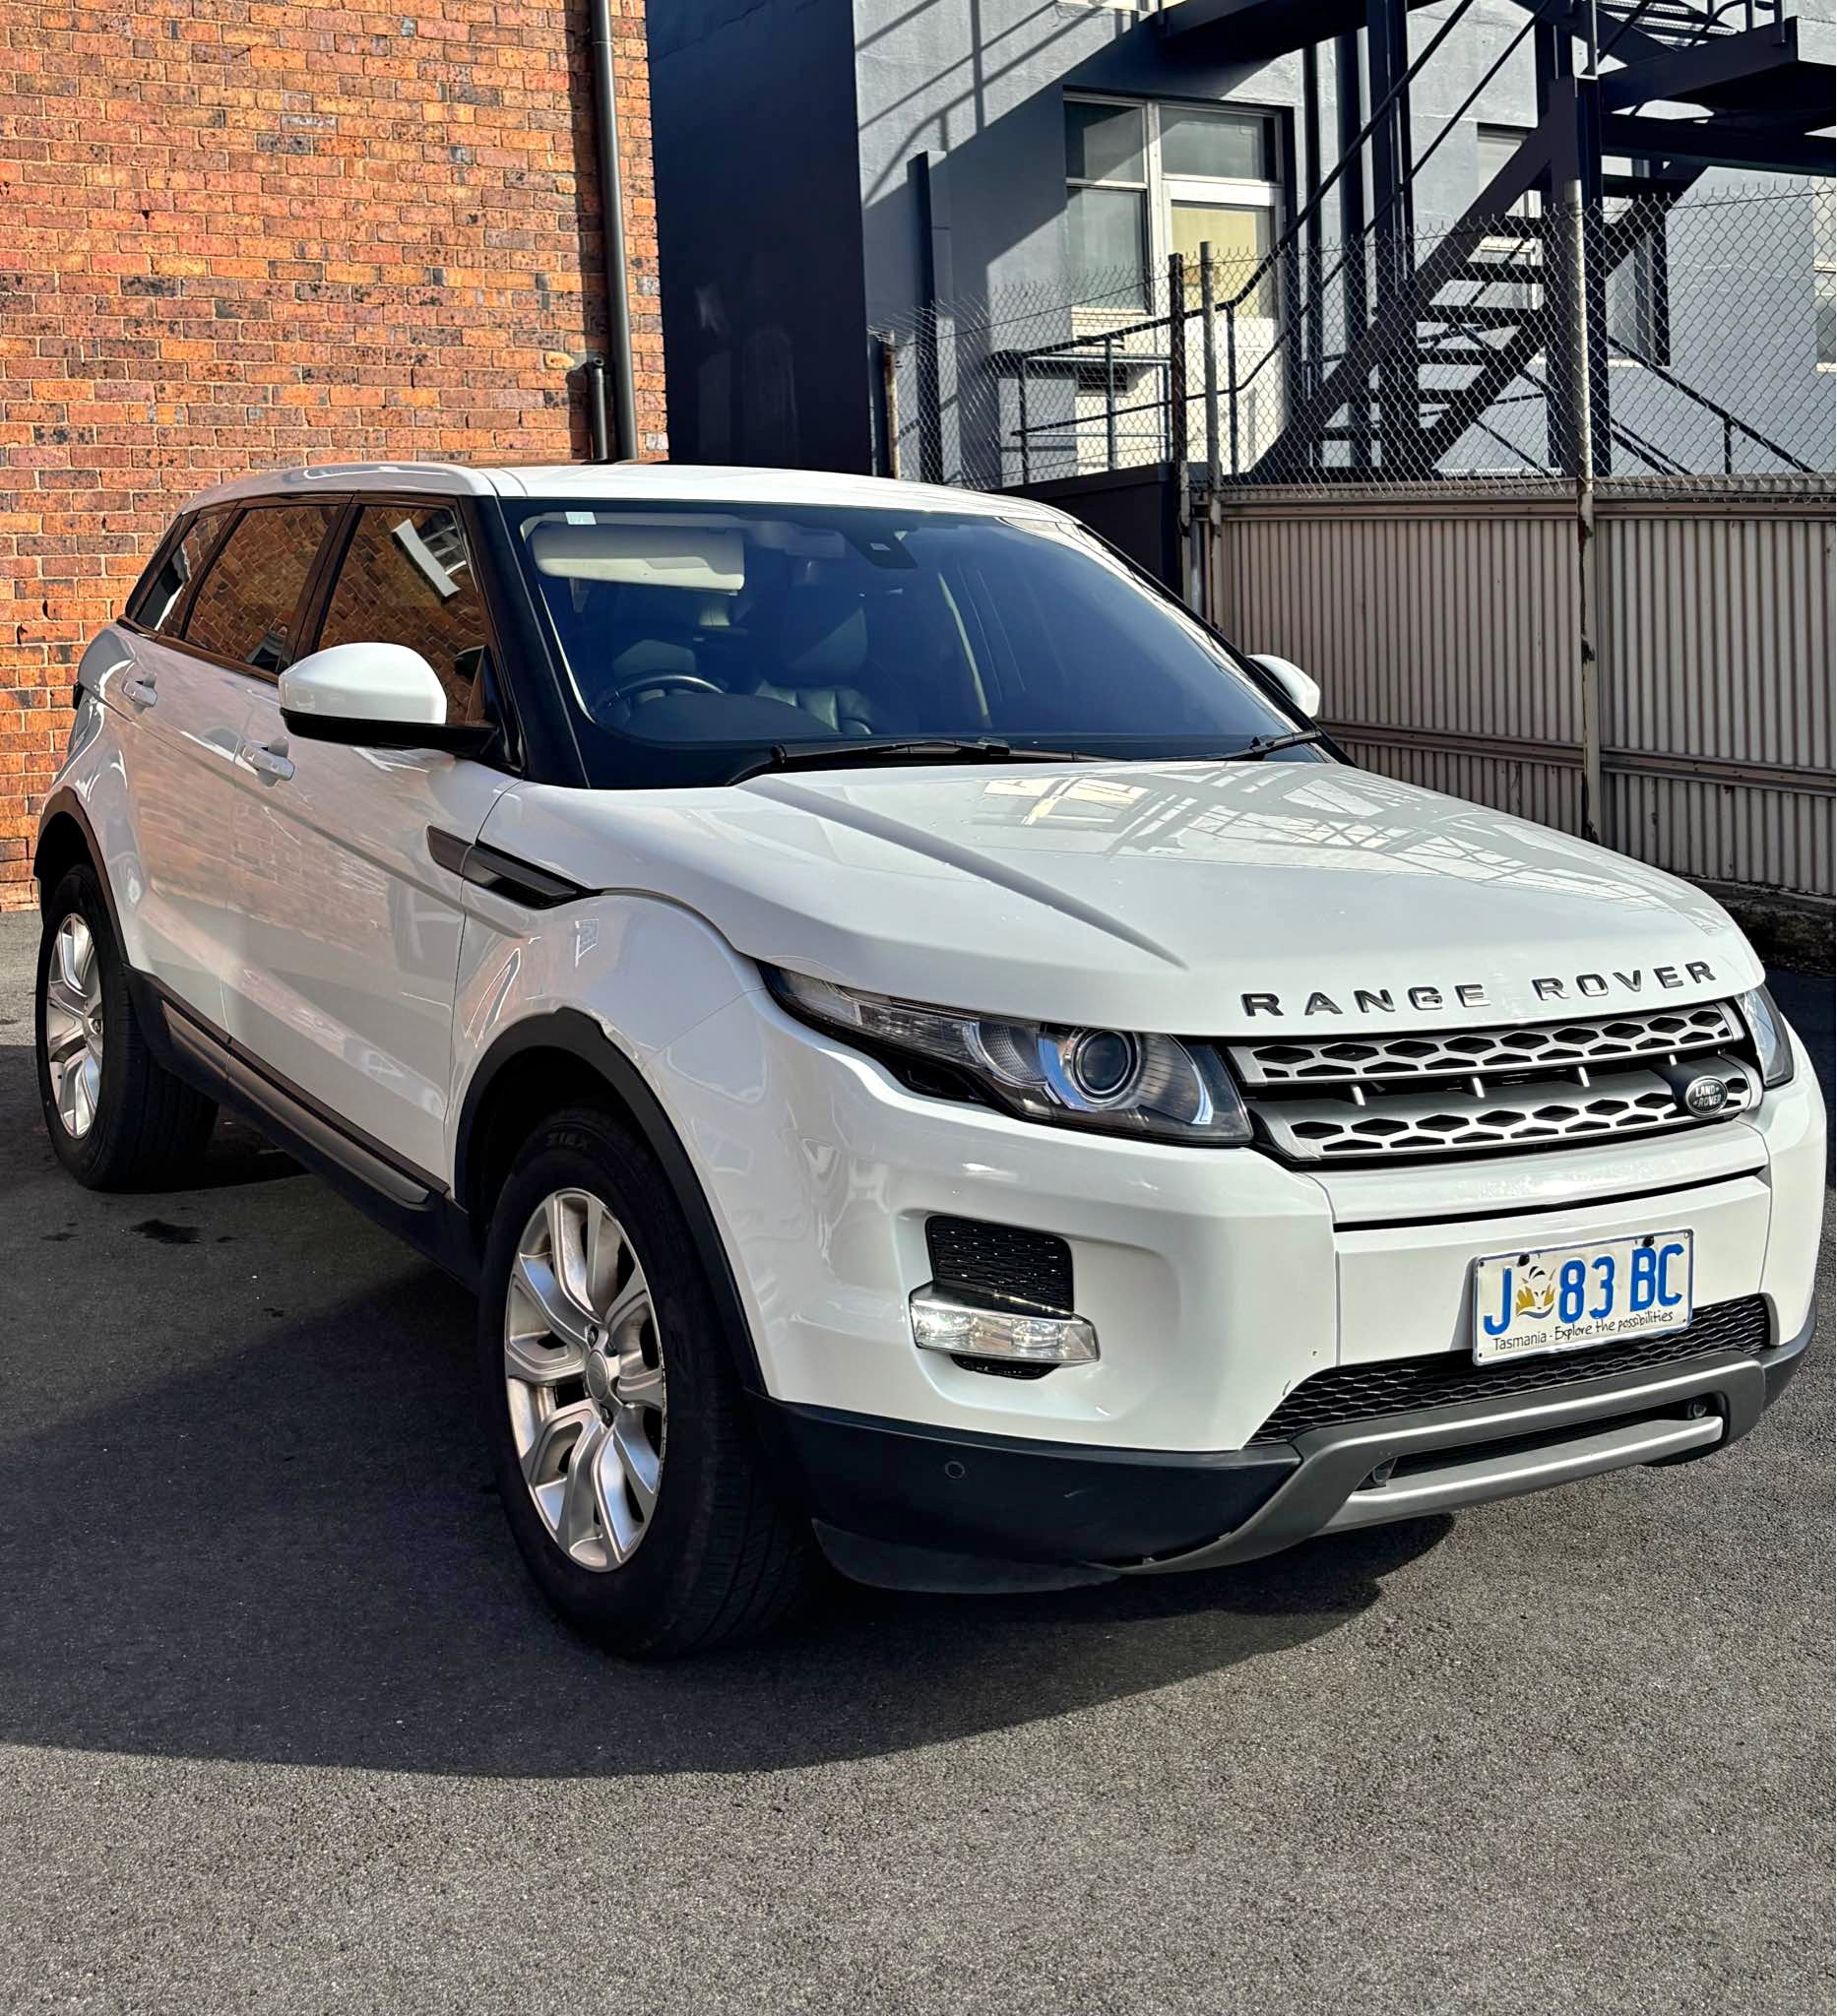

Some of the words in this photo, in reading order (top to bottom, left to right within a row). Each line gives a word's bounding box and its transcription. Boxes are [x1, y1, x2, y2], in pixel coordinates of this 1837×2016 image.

[1241, 984, 1490, 1017] RANGE
[1532, 961, 1718, 1001] ROVER
[1695, 1085, 1716, 1097] LAND
[1484, 1268, 1512, 1336] J
[1558, 1256, 1615, 1324] 83
[1630, 1243, 1685, 1312] BC
[1492, 1333, 1547, 1352] Tasmania
[1554, 1324, 1593, 1341] Explore
[1596, 1318, 1615, 1333] the
[1617, 1310, 1674, 1332] possibilities
